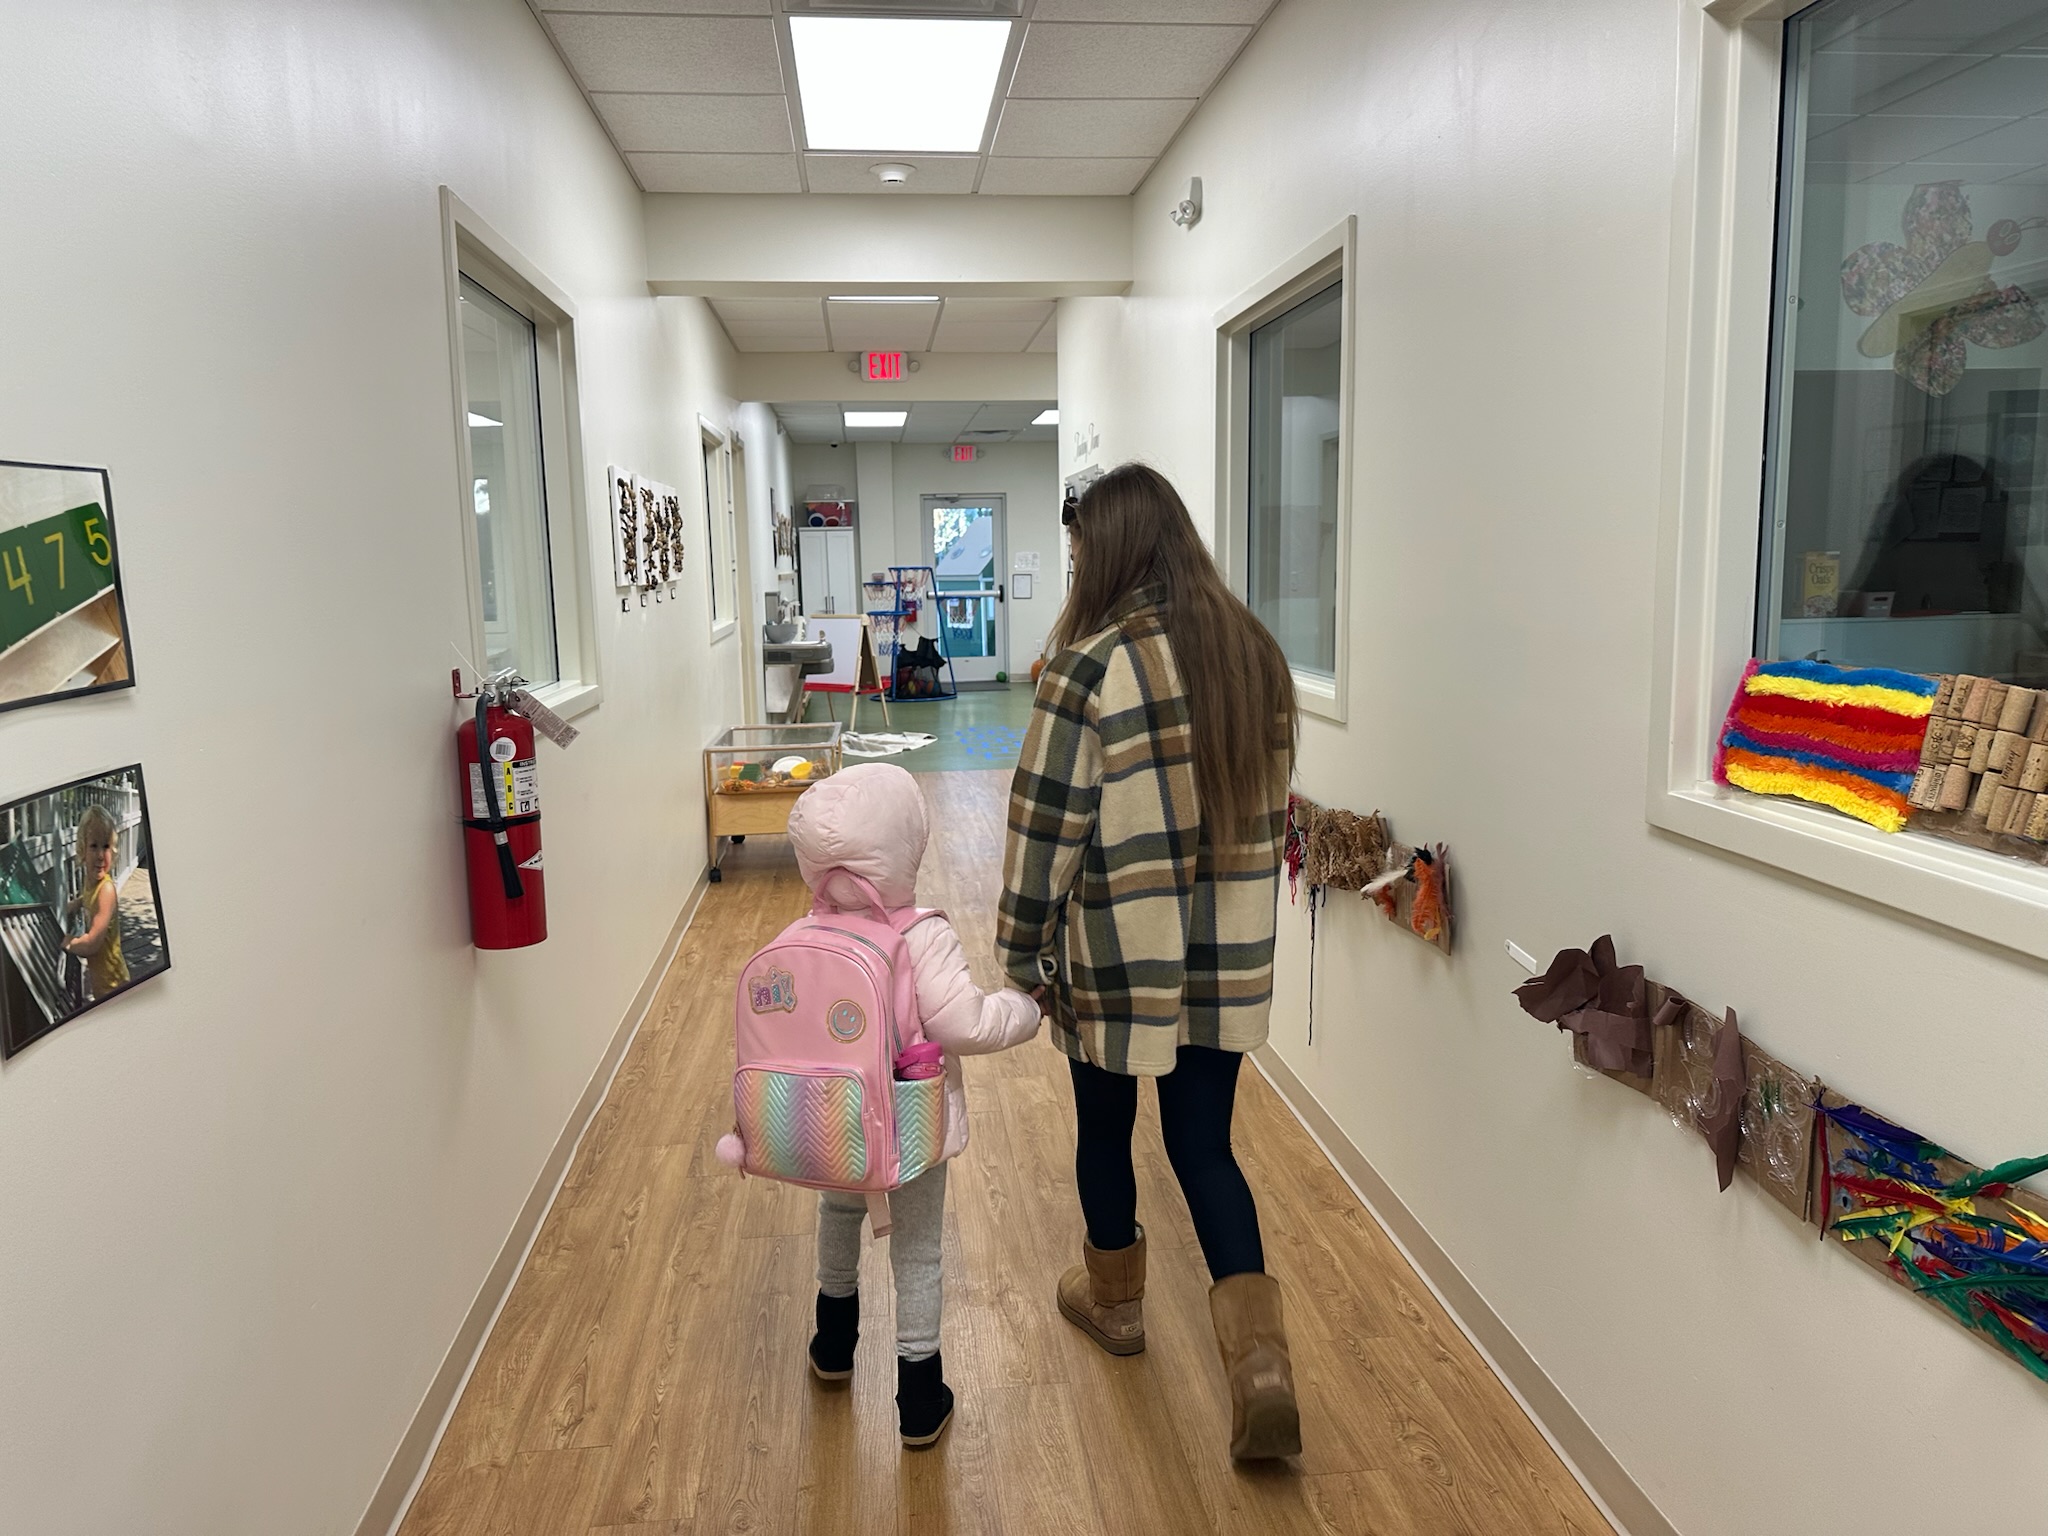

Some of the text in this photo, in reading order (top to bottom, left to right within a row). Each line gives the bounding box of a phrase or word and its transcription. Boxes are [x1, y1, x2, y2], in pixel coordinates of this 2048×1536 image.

[868, 352, 902, 380] EXIT
[954, 446, 973, 461] EXIT
[1809, 562, 1835, 576] Crispy
[1811, 574, 1831, 585] Oats
[506, 767, 511, 776] A
[507, 785, 512, 793] B
[508, 802, 513, 811] C
